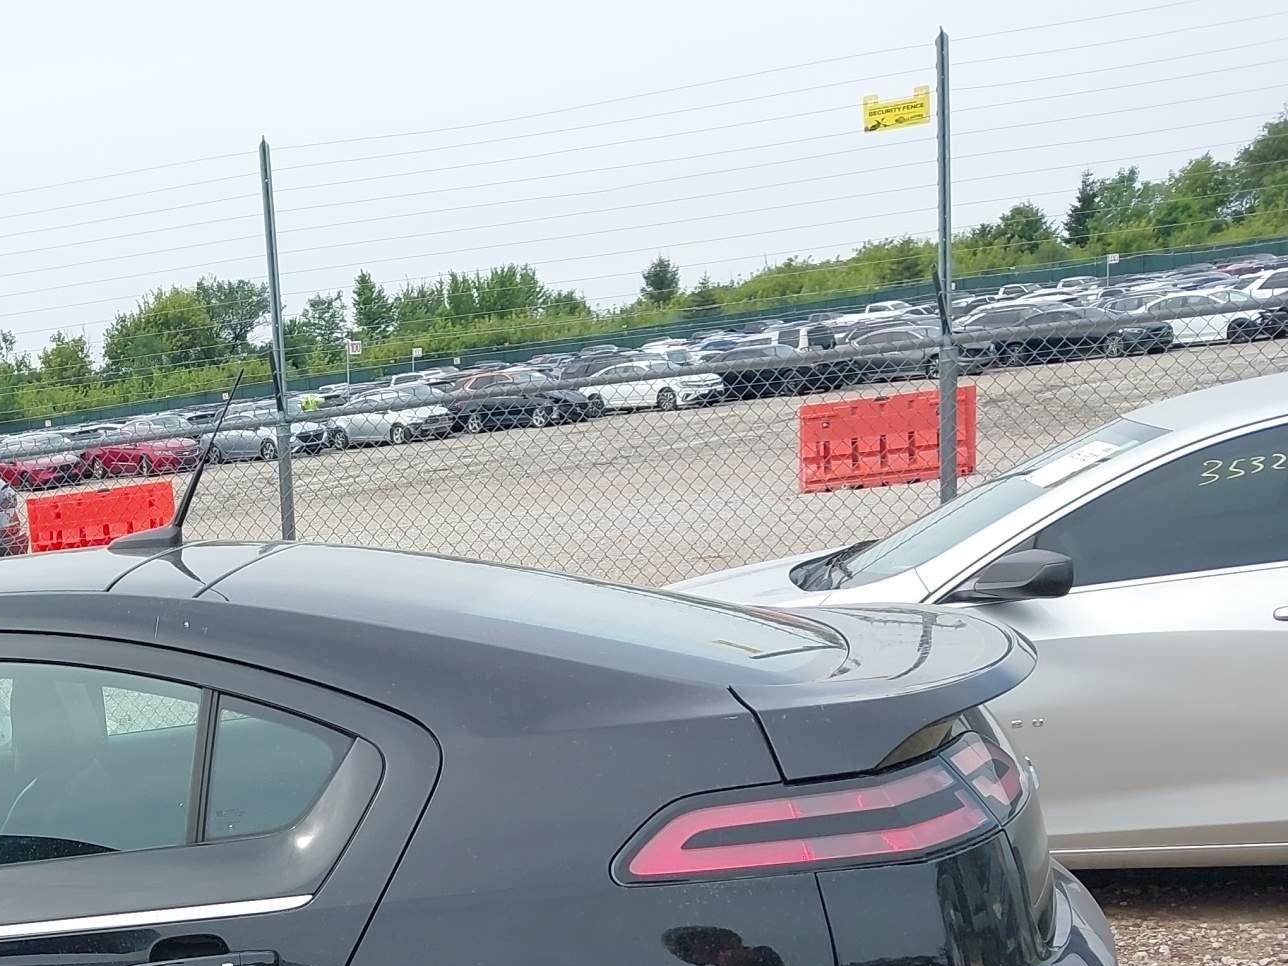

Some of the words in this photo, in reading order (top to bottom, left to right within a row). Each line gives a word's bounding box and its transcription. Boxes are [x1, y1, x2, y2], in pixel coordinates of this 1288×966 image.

[868, 107, 901, 117] SECURITY
[902, 102, 924, 111] FENCE
[1198, 453, 1288, 486] 3532
